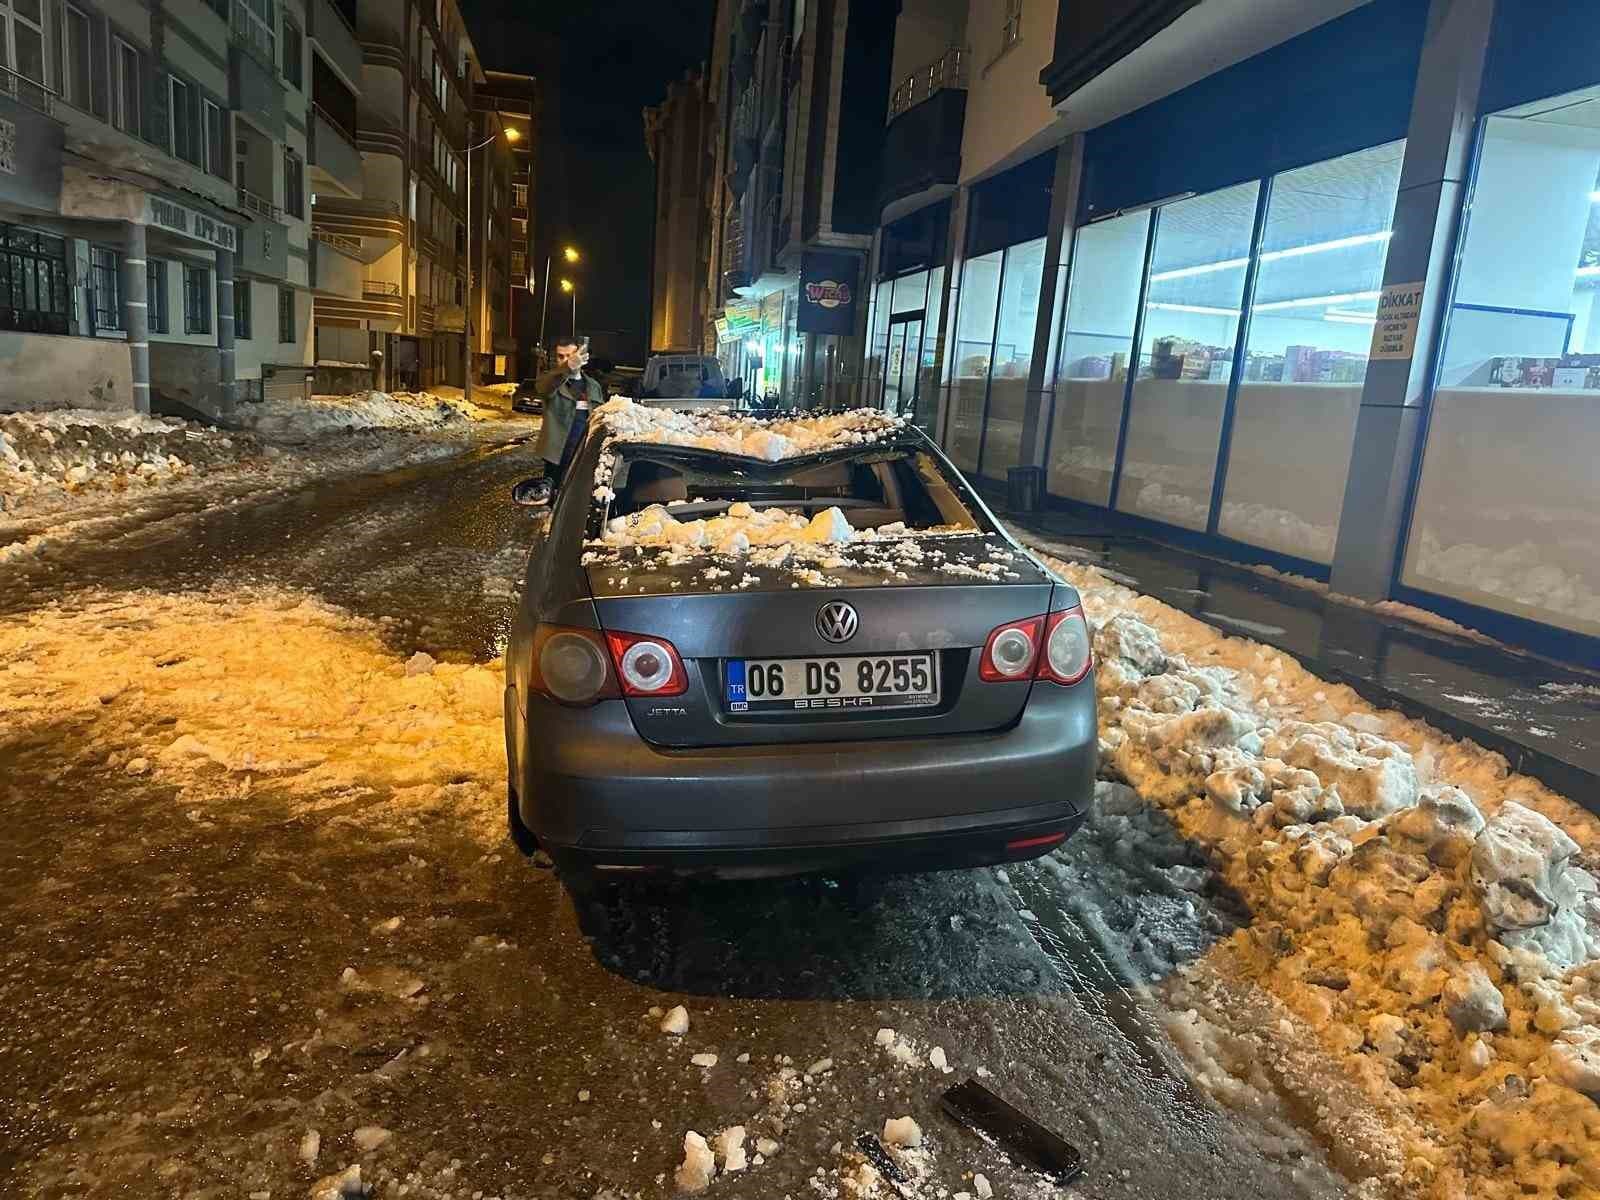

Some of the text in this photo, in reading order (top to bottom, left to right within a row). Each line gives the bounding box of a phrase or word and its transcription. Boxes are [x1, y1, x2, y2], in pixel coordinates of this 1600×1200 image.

[1381, 291, 1420, 309] DİKKAT
[749, 658, 928, 697] 06 DS 8255
[730, 684, 745, 694] TR
[648, 707, 688, 718] JETTA
